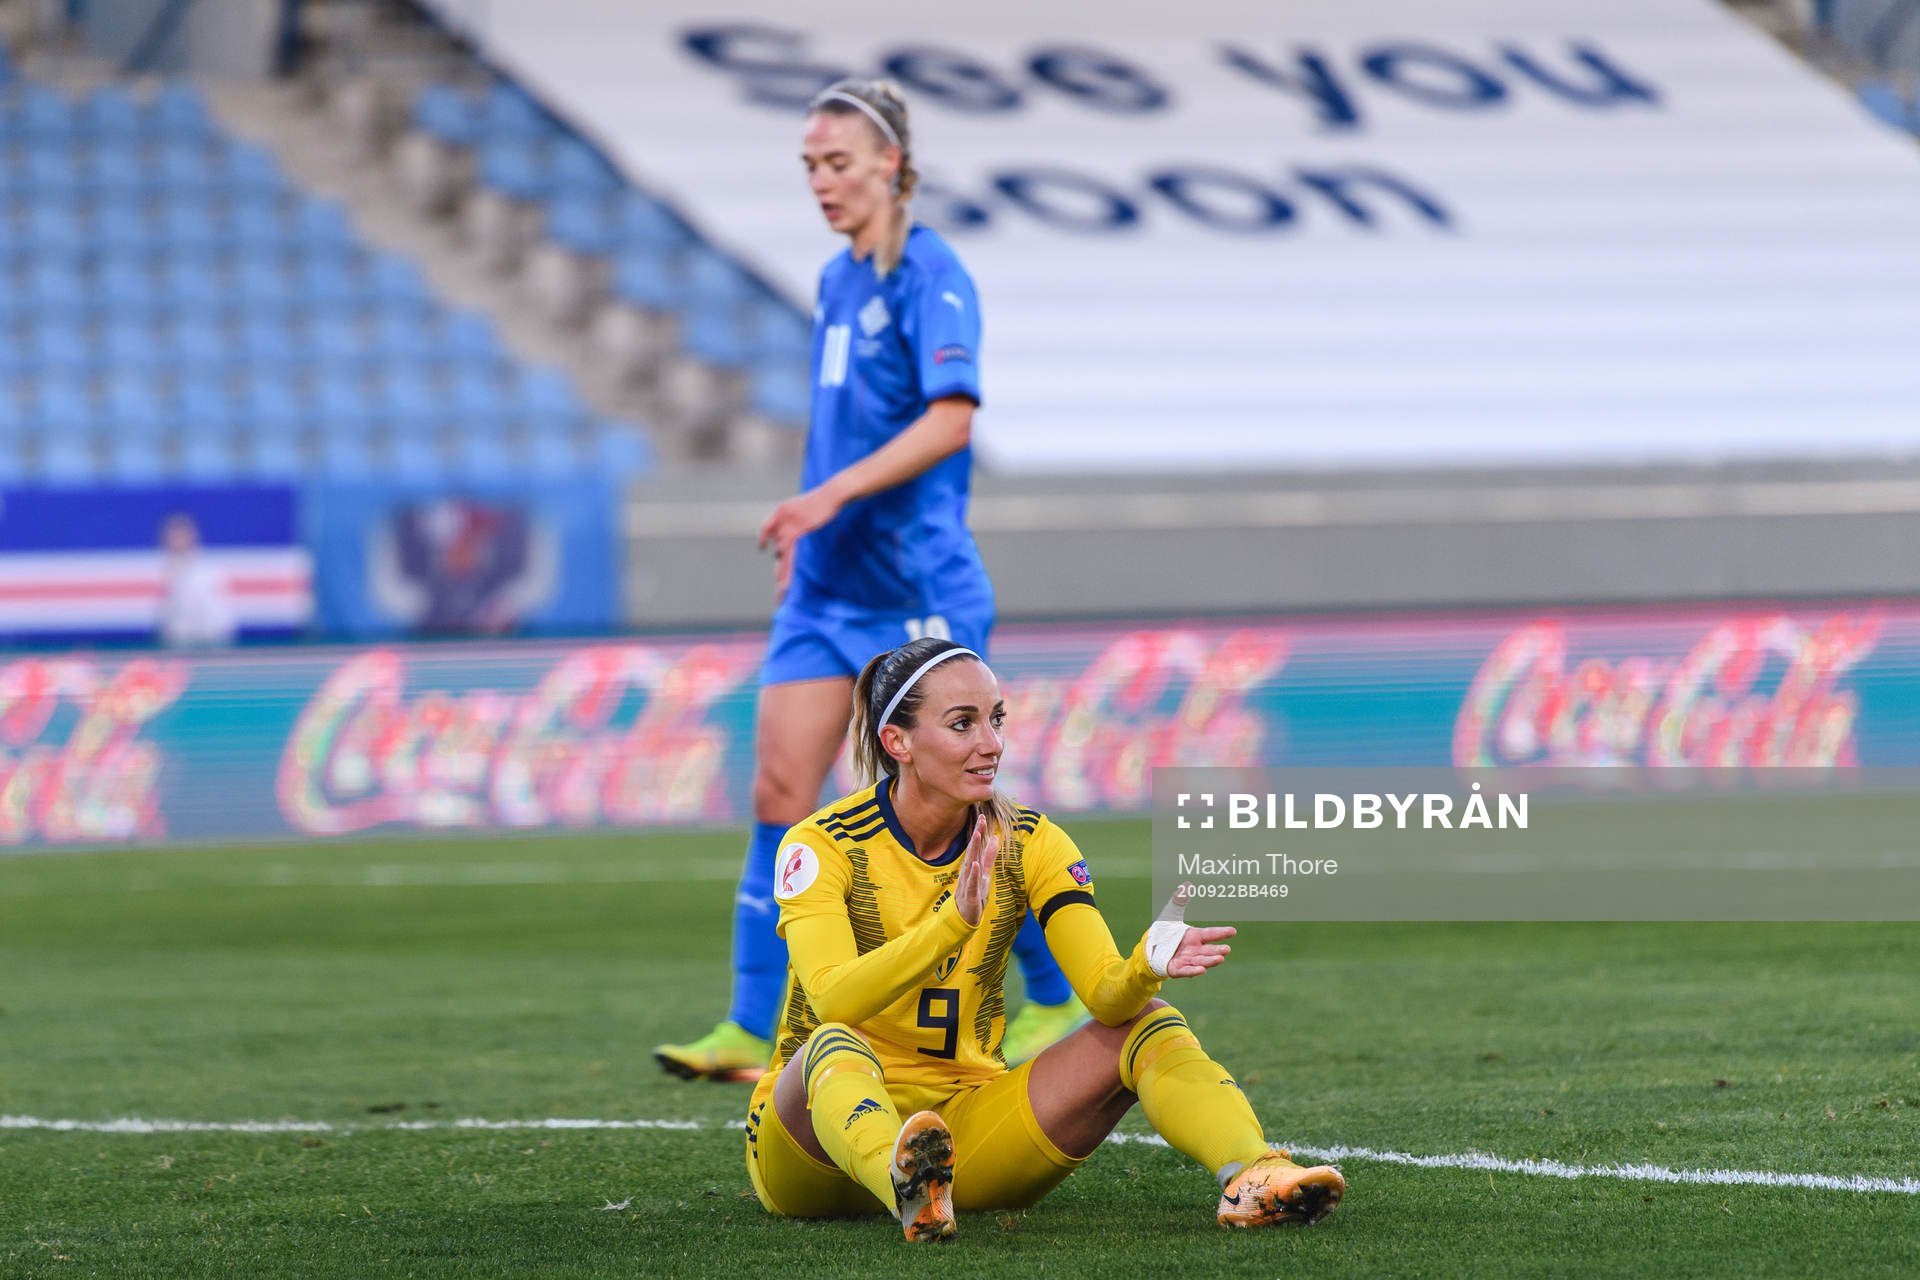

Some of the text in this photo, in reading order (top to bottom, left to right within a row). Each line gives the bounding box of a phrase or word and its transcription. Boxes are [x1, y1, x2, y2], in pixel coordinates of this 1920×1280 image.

[680, 24, 1660, 132] See you
[917, 988, 960, 1059] 9
